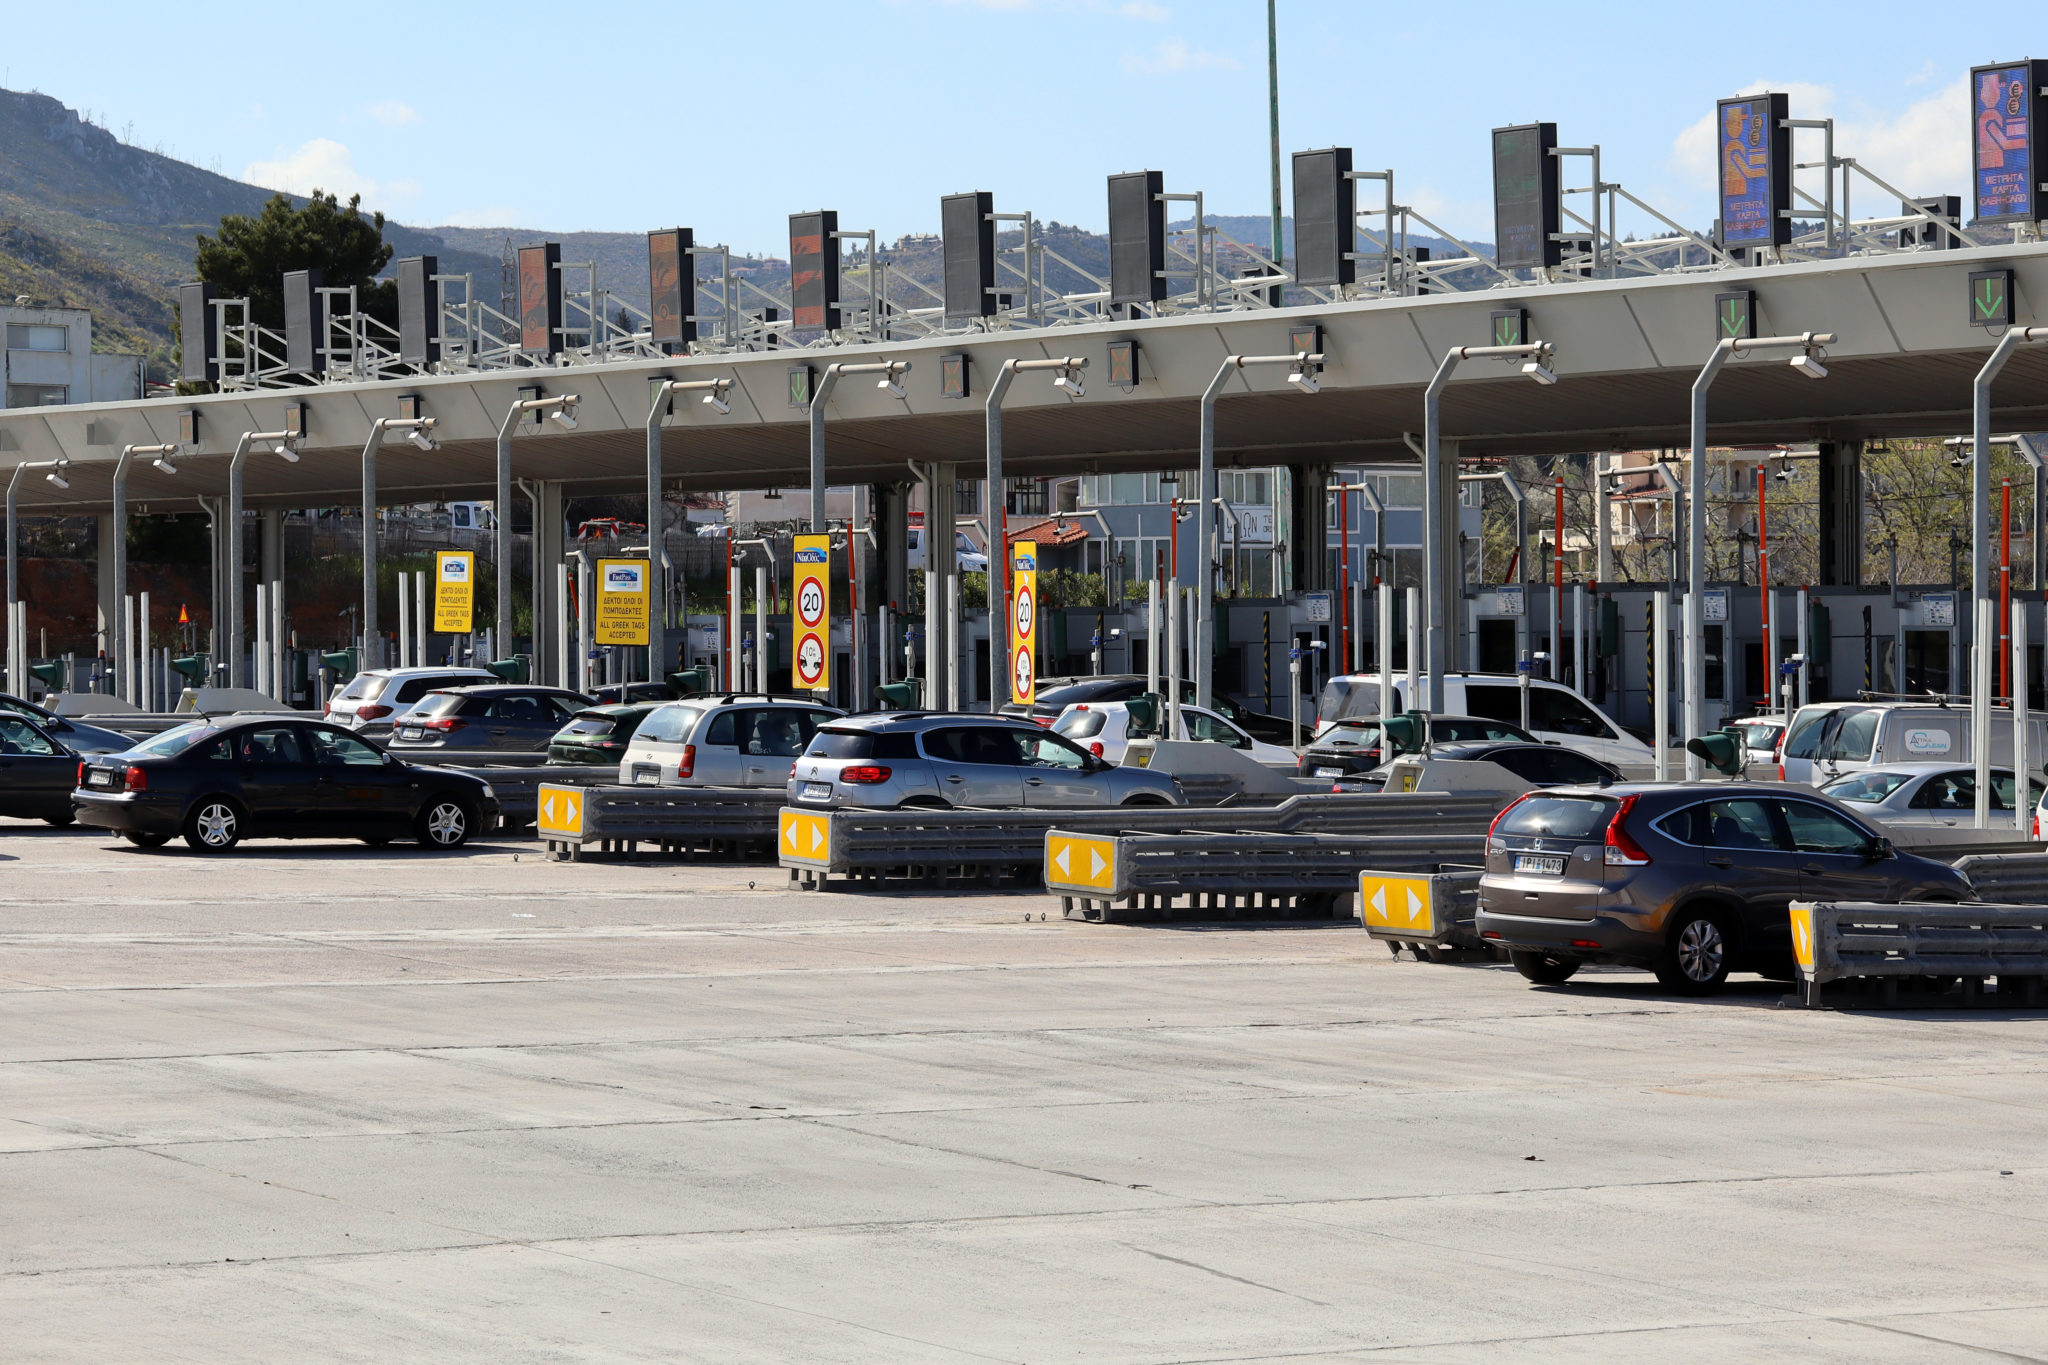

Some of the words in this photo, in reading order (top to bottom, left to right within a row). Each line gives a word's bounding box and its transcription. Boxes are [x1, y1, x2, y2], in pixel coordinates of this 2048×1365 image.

[603, 597, 622, 605] ΔΕΚΤΟΙ
[623, 597, 636, 605] ΟΛΟΙ
[803, 592, 819, 612] 20
[603, 606, 642, 615] ΠΟΜΠΟΔΕΚΤΕΣ
[1019, 602, 1030, 622] 20
[600, 621, 610, 629] ALL
[611, 621, 630, 629] GREEK
[631, 621, 646, 630] TAGS
[608, 631, 636, 639] ACCEPTED
